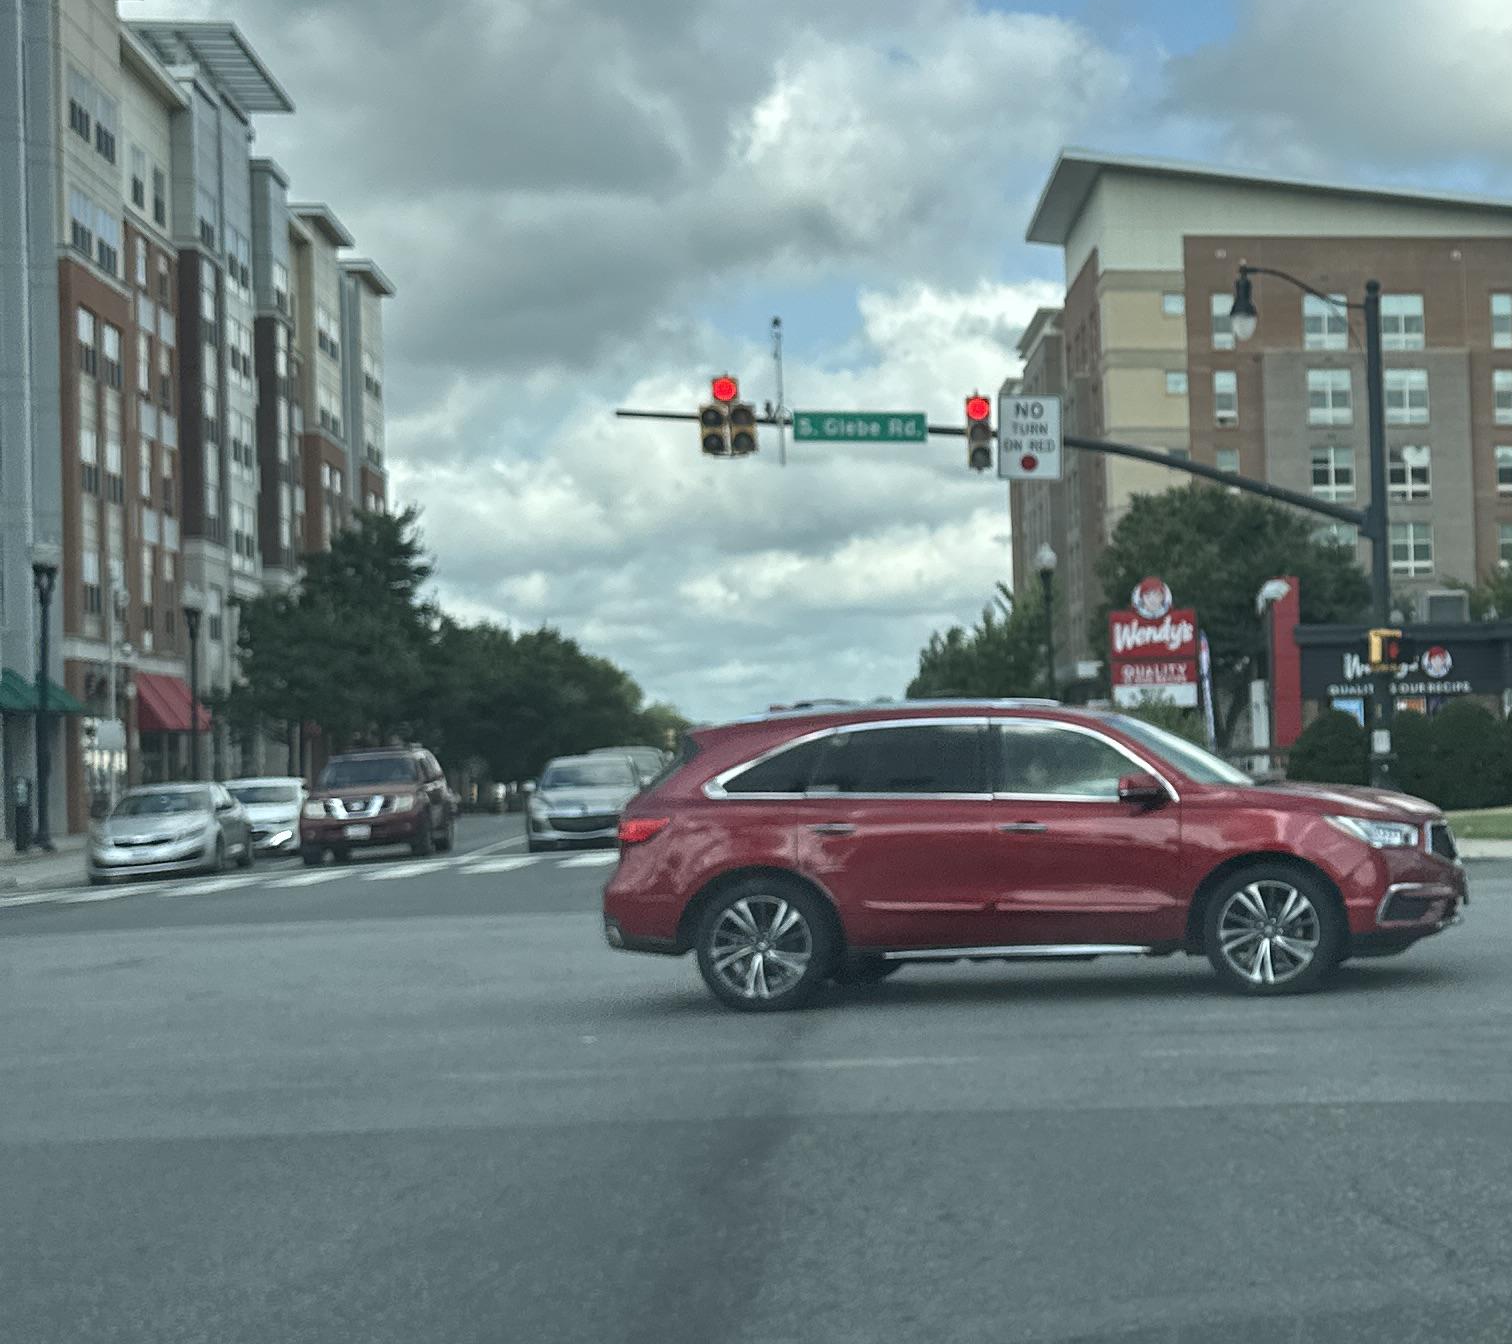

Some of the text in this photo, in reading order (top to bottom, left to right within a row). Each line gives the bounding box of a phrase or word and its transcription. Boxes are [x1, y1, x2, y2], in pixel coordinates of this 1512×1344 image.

[1015, 401, 1044, 419] NO
[1012, 422, 1049, 435] TURN
[1003, 438, 1022, 452] ON
[1113, 615, 1194, 653] Wendy's
